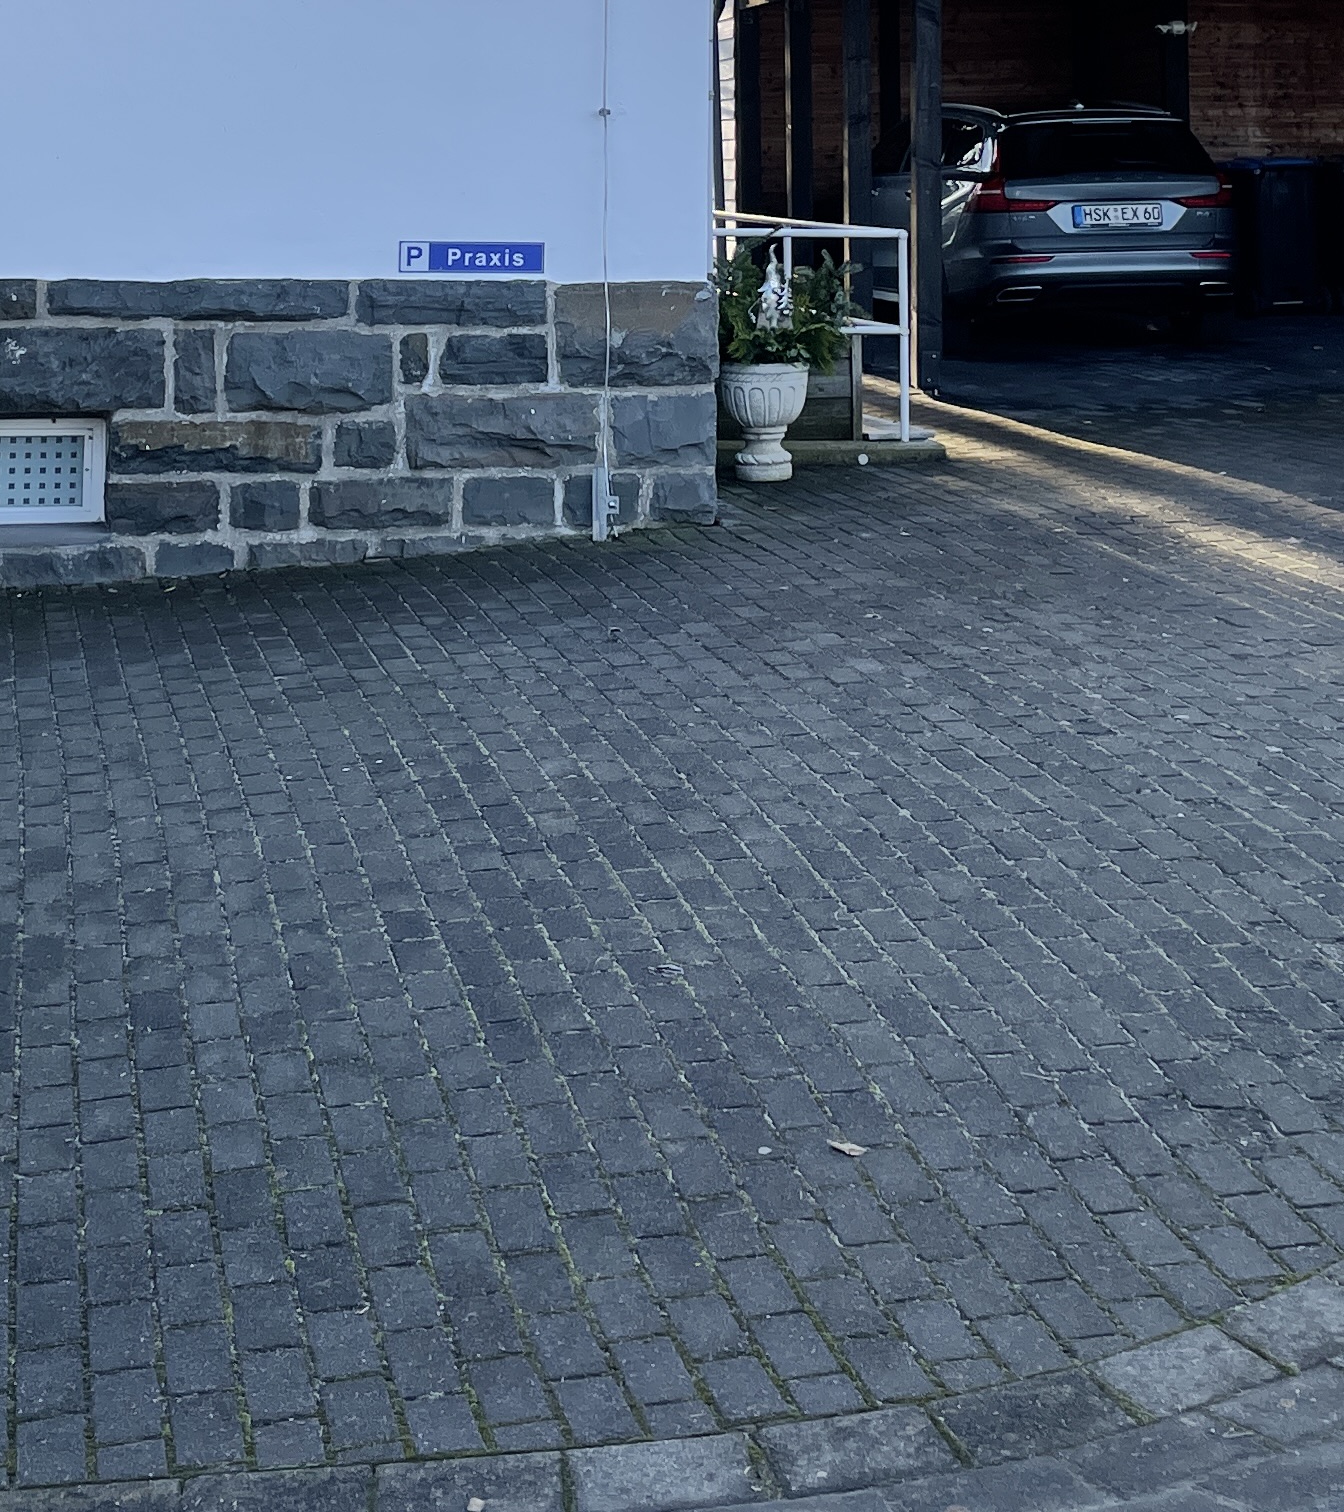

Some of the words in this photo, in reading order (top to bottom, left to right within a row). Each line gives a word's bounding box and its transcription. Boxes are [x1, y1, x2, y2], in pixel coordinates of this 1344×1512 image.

[1083, 207, 1112, 222] HSK
[1121, 207, 1140, 221] EX
[1143, 206, 1161, 220] 60
[406, 246, 423, 267] P
[447, 247, 525, 267] Praxis
